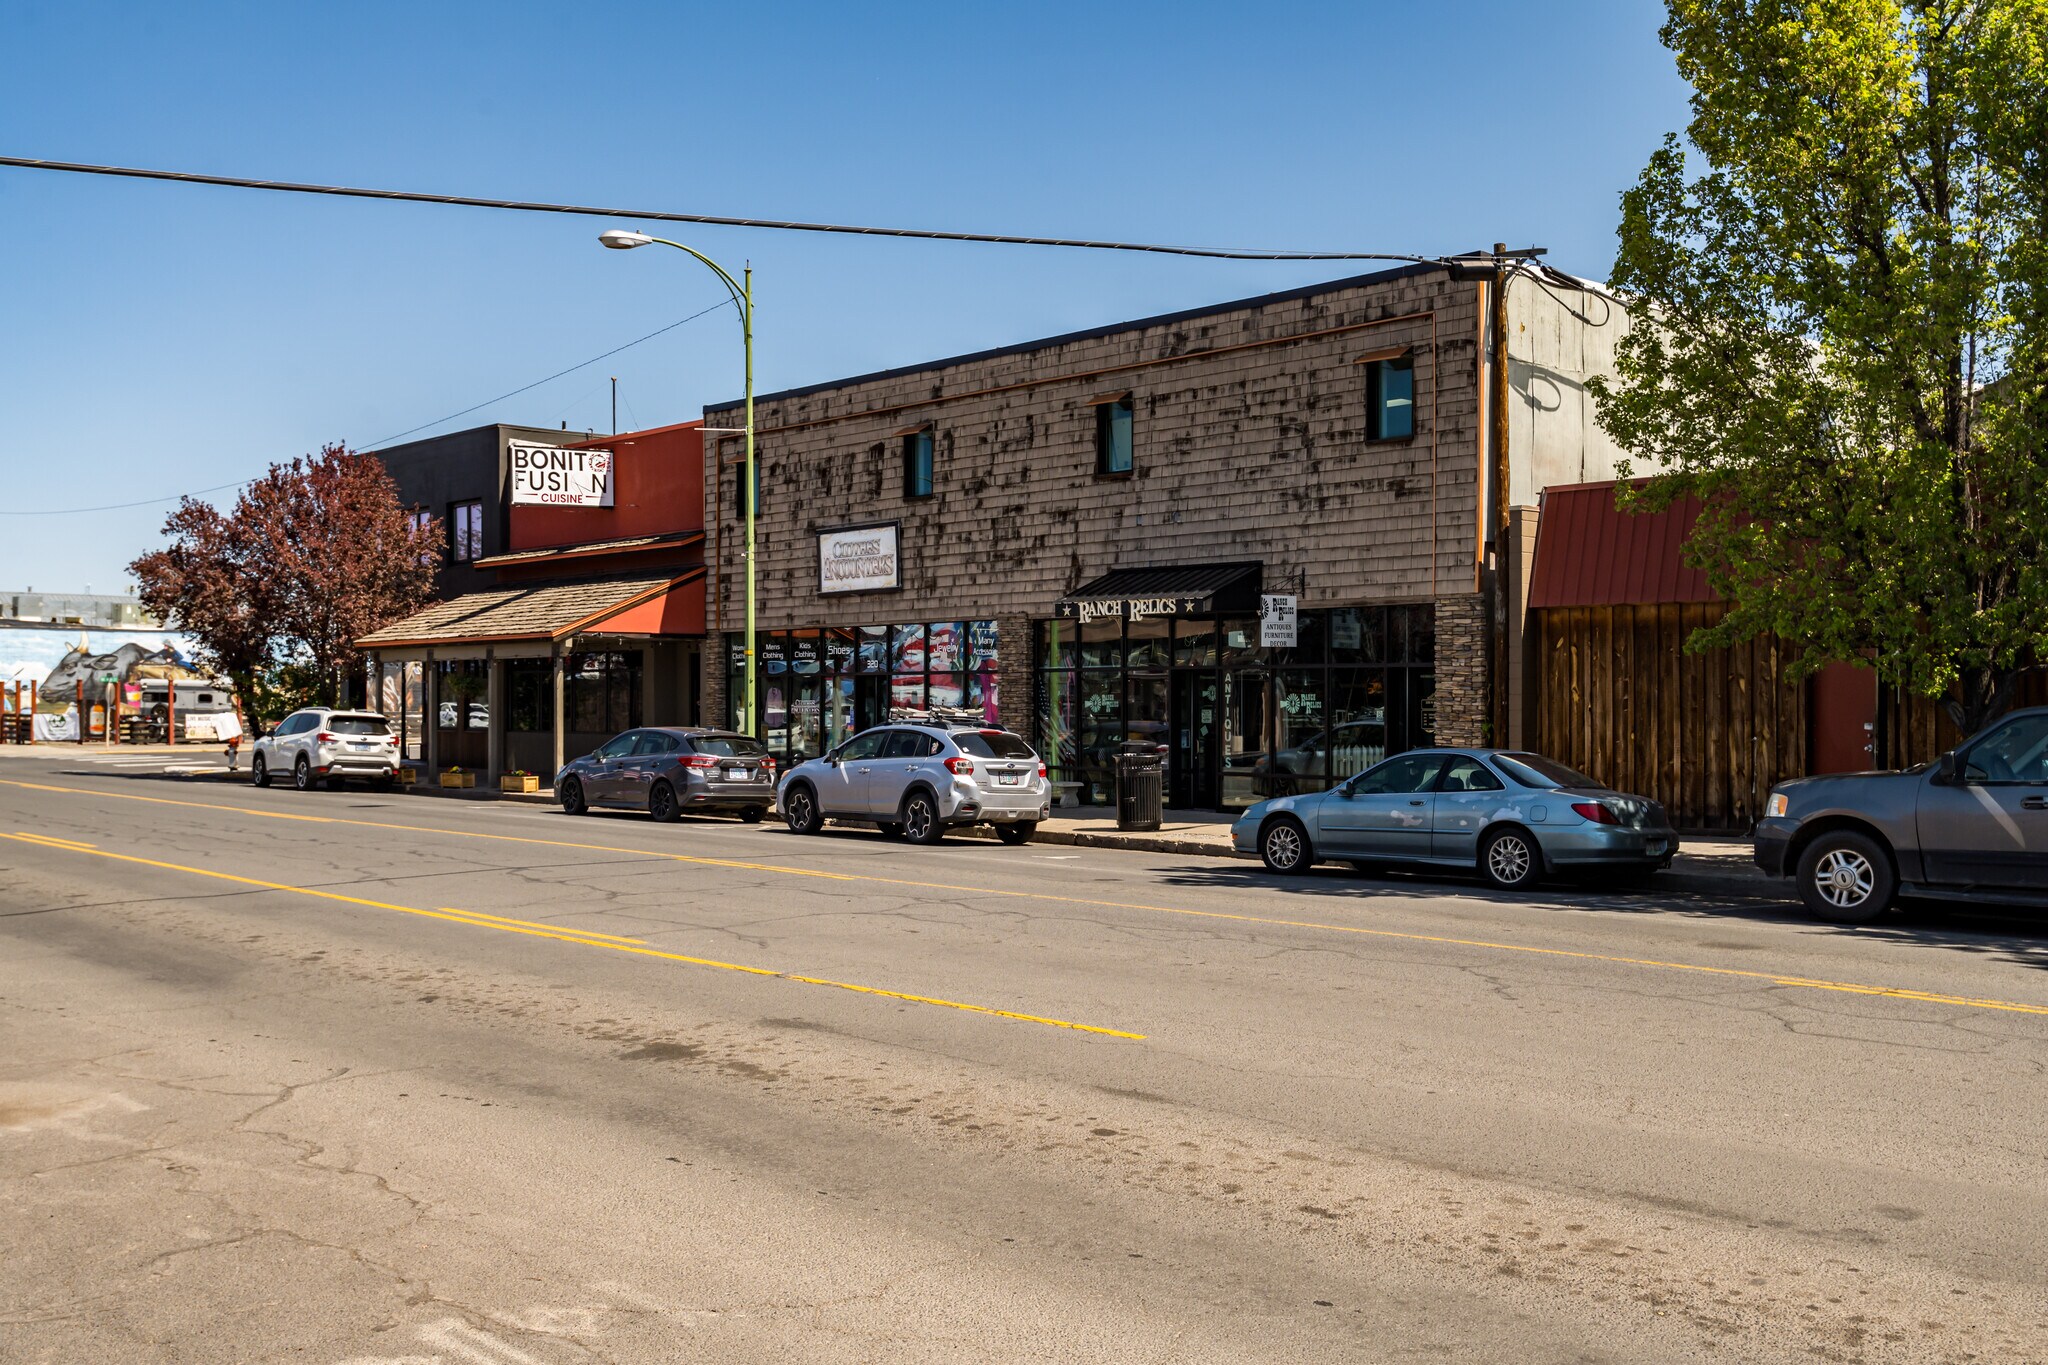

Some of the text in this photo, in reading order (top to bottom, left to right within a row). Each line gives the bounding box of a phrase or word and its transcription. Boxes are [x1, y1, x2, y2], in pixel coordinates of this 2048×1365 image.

[541, 494, 582, 504] CUISINE
[1078, 598, 1176, 624] RANCH RELICS
[828, 646, 850, 654] Shoes
[934, 643, 958, 653] Jewelry
[762, 652, 784, 660] Clothing
[794, 651, 816, 659] Clothing
[867, 660, 879, 668] 320
[1224, 673, 1232, 768] ANTIQUES
